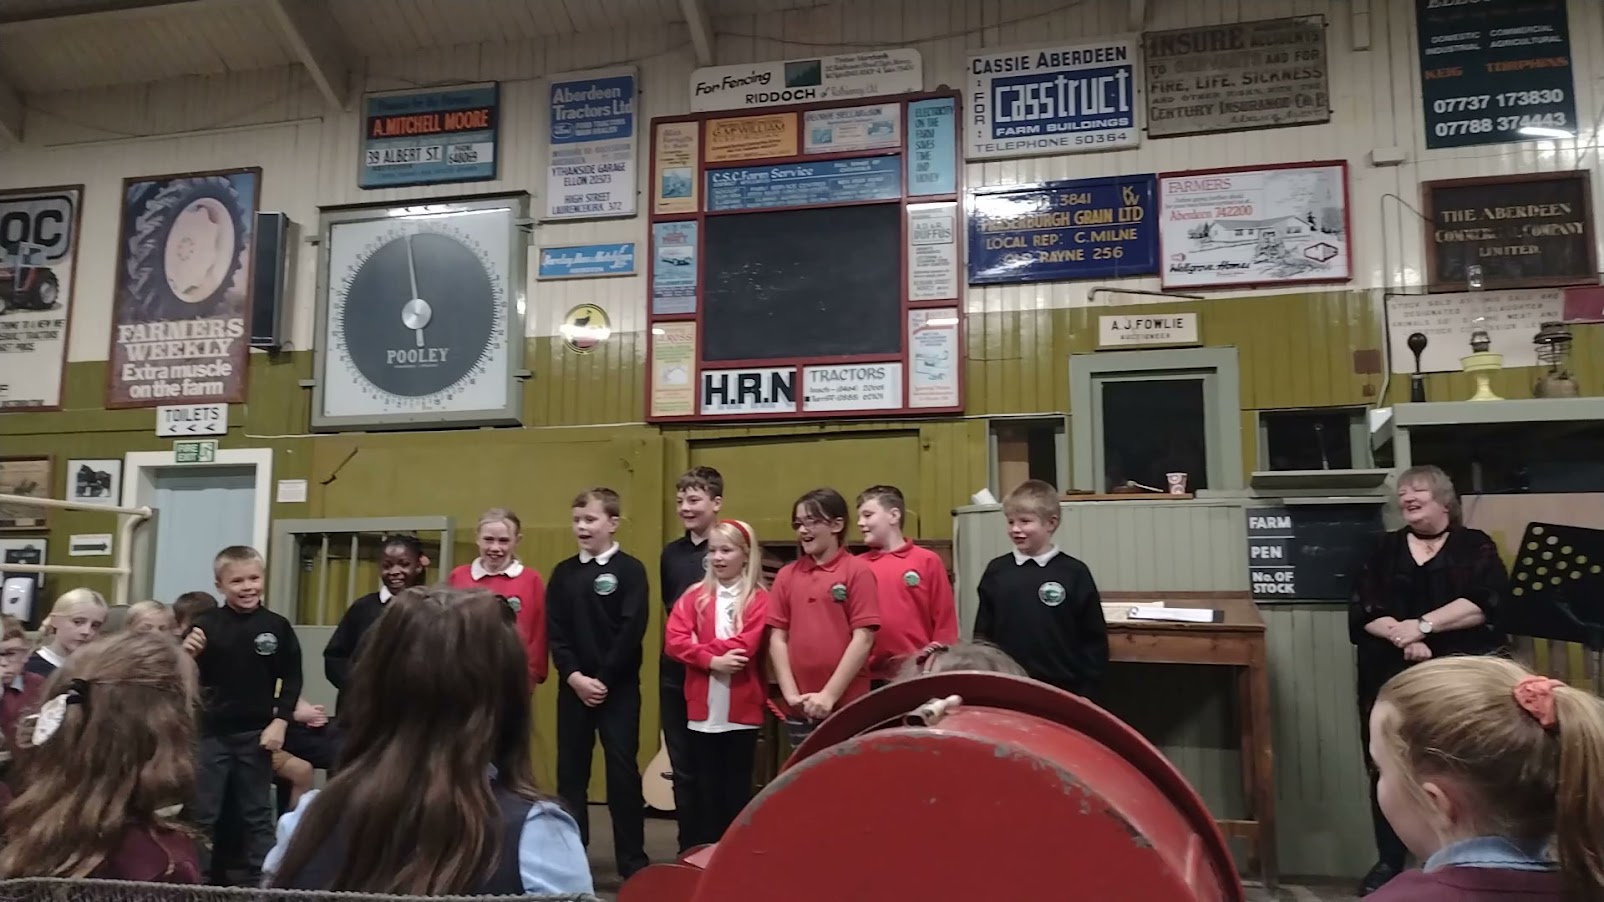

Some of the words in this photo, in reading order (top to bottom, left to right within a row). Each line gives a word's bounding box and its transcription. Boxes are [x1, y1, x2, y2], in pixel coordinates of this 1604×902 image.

[1149, 27, 1244, 58] INSURE
[1431, 31, 1481, 44] DOMESTIC
[1489, 25, 1554, 37] COMMERCIAL
[1425, 43, 1481, 56] INDUSTRIAL
[1489, 35, 1563, 48] AGRICULTURAL
[972, 55, 1030, 75] CASSIE
[1036, 46, 1127, 69] ABERDEEN
[1265, 52, 1289, 64] AND
[1295, 50, 1320, 62] FOR
[1150, 64, 1167, 75] TO
[1242, 67, 1323, 86] SICKNESS
[695, 83, 721, 96] For
[722, 71, 771, 91] Fencing
[552, 84, 621, 104] Aberdeen
[746, 89, 815, 104] RIDDOCH
[1433, 95, 1490, 114] 07737
[1496, 89, 1564, 108] 173830
[552, 104, 611, 120] Tractors
[612, 98, 633, 115] Ltd
[1150, 104, 1214, 121] CENTURY
[1220, 97, 1290, 114] INSURANCE
[444, 110, 488, 130] MOORE
[915, 118, 925, 128] ON
[927, 118, 940, 128] THE
[996, 124, 1041, 136] FARM
[1046, 117, 1130, 132] BUILDINGS
[1435, 118, 1493, 137] 07788
[1496, 112, 1566, 132] 374443
[916, 128, 935, 139] FARM
[916, 140, 935, 150] SAVES
[974, 137, 1070, 153] TELEPHONE
[1075, 132, 1128, 145] 50364
[368, 150, 380, 164] 39
[383, 148, 422, 164] ALBERT
[916, 151, 931, 160] TIME
[598, 162, 626, 173] GARAGE
[770, 166, 814, 180] Service
[564, 176, 588, 186] ELLON
[1168, 178, 1232, 194] FARMERS
[586, 192, 611, 202] STREET
[1060, 192, 1092, 206] 3841
[1074, 208, 1114, 226] GRAIN
[1118, 206, 1144, 222] LTD
[1170, 208, 1212, 222] Aberdeen
[1214, 205, 1254, 218] 742200
[1441, 208, 1477, 223] THE
[1480, 202, 1572, 220] ABERDEEN
[986, 236, 1028, 250] LOCAL
[1039, 249, 1085, 264] RAYNE
[1092, 246, 1124, 260] 256
[1478, 245, 1542, 258] LIMITED
[117, 318, 244, 344] FARMERS
[124, 338, 234, 361] WEEKLY
[387, 348, 449, 364] POOLEY
[122, 363, 169, 381] Extra
[170, 359, 232, 378] muscle
[809, 368, 886, 383] TRACTORS
[129, 384, 150, 398] on
[152, 380, 181, 398] the
[182, 378, 224, 396] farm
[164, 407, 220, 422] TOILETS
[1248, 516, 1292, 528] FARM
[1250, 546, 1282, 558] PEN
[1274, 572, 1295, 582] OF
[1253, 583, 1296, 594] STOCK
